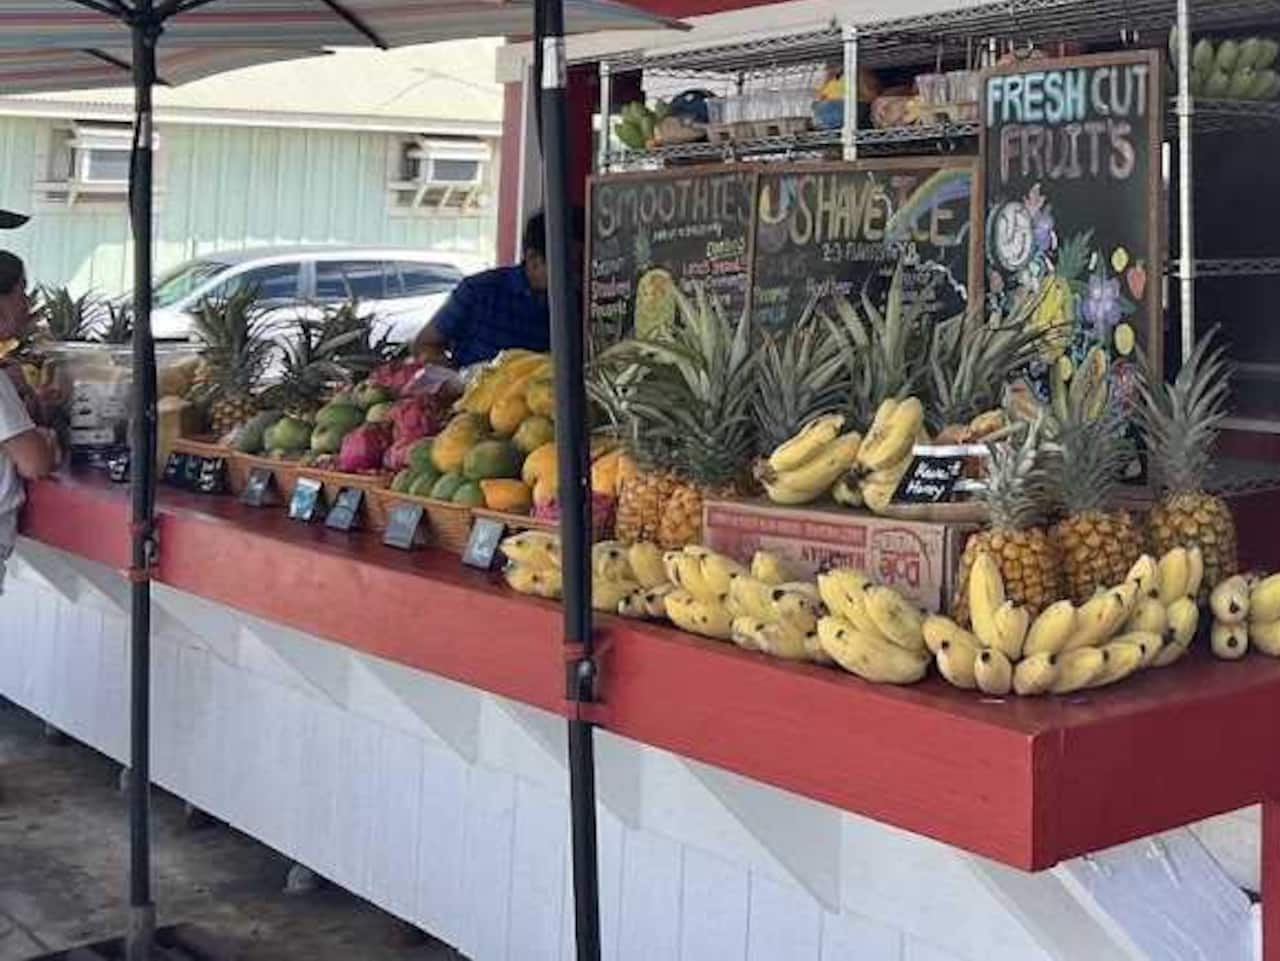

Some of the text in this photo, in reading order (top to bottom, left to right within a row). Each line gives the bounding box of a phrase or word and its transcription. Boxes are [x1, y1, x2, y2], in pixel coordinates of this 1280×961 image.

[986, 65, 1148, 127] FRESH CUT
[790, 174, 885, 246] SHAVE
